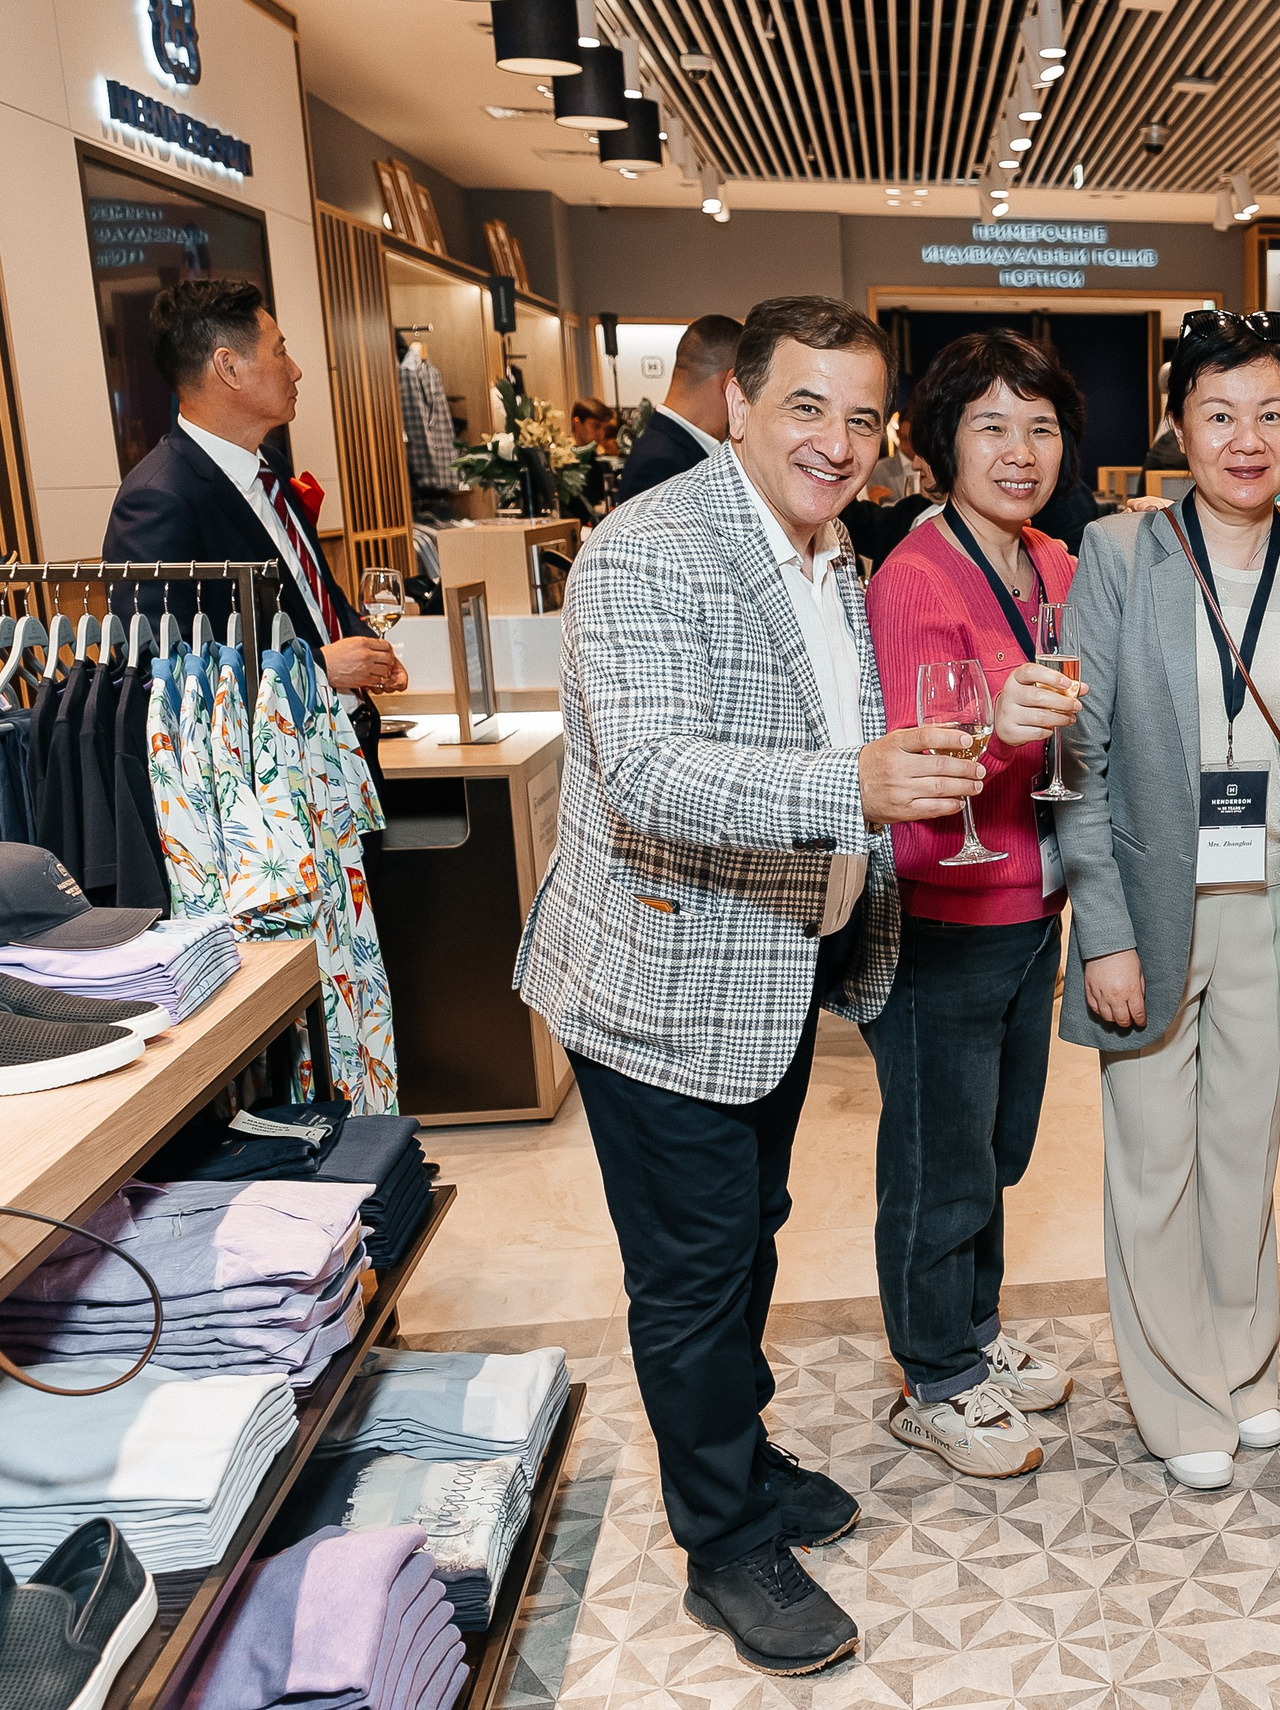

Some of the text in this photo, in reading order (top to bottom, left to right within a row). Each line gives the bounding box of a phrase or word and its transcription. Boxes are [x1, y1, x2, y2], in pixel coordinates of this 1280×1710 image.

[106, 79, 253, 177] HENDERSON
[972, 223, 1108, 244] ПРИМЕРОЧНЫЕ
[922, 244, 1158, 267] ИНДИВИДУАЛЬНЫЙ ПОШИВ
[999, 268, 1085, 288] ПОРТНОЙ
